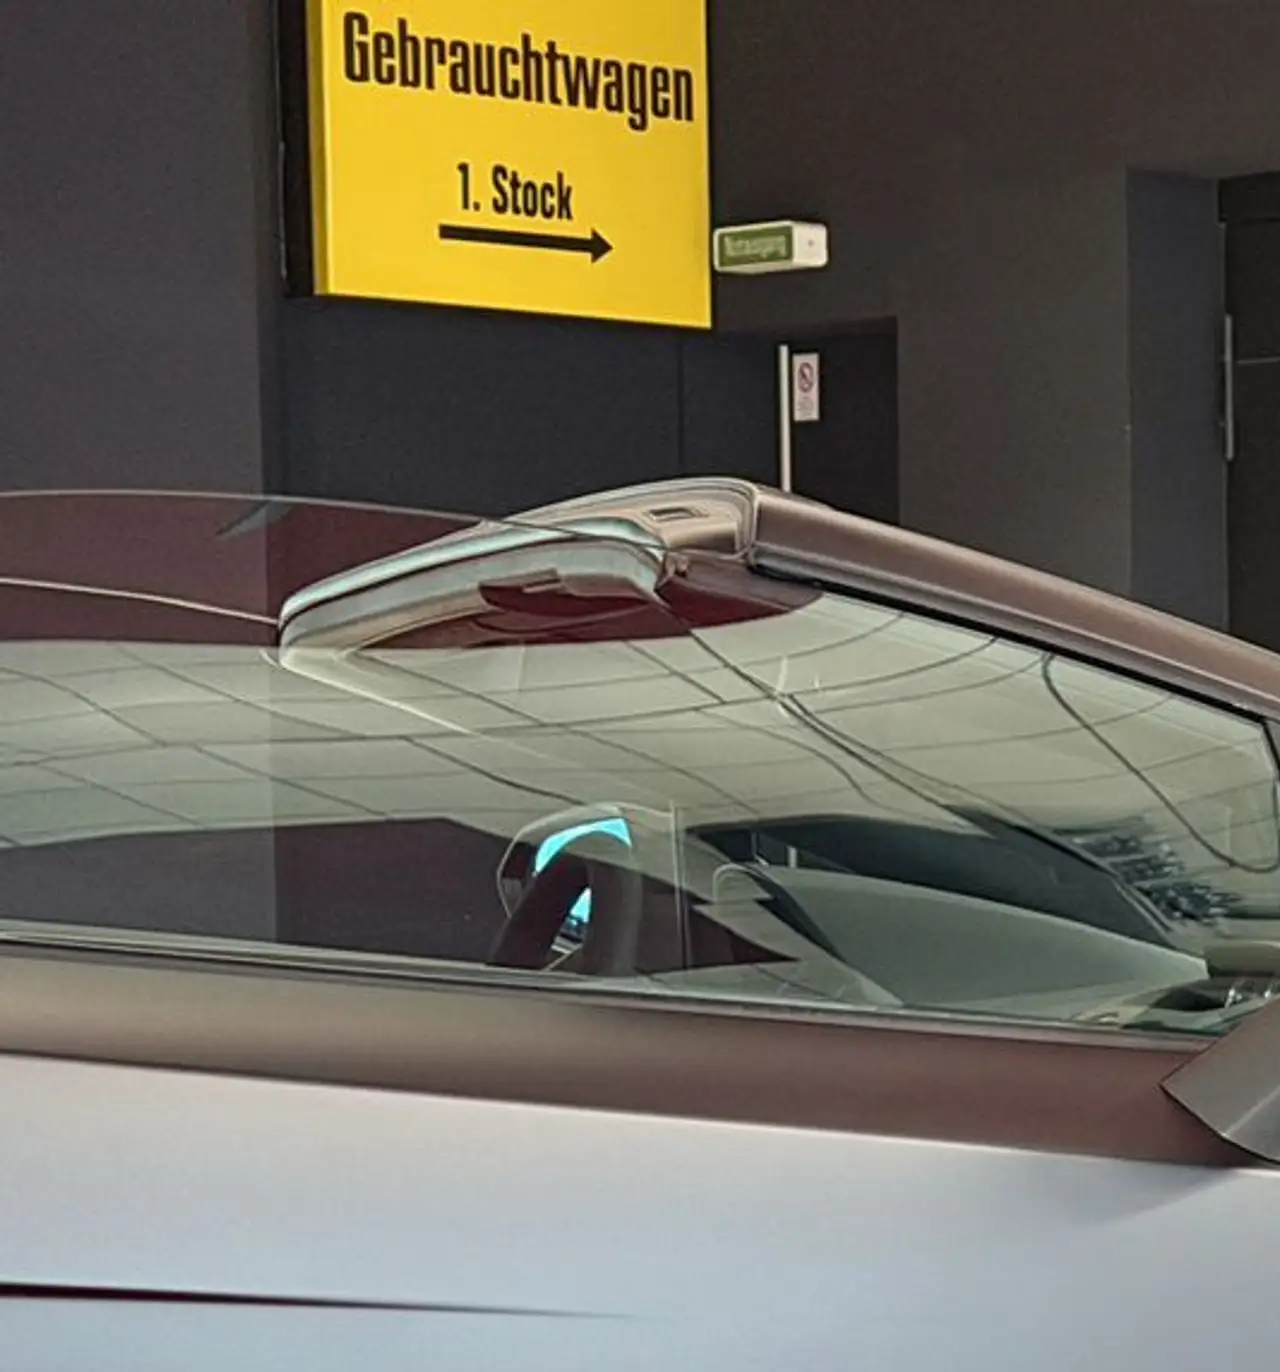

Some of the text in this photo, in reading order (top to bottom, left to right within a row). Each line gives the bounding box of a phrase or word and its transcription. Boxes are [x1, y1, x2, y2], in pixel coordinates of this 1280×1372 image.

[342, 10, 694, 132] Gebrauchtwagen
[457, 161, 574, 221] 1. Stock
